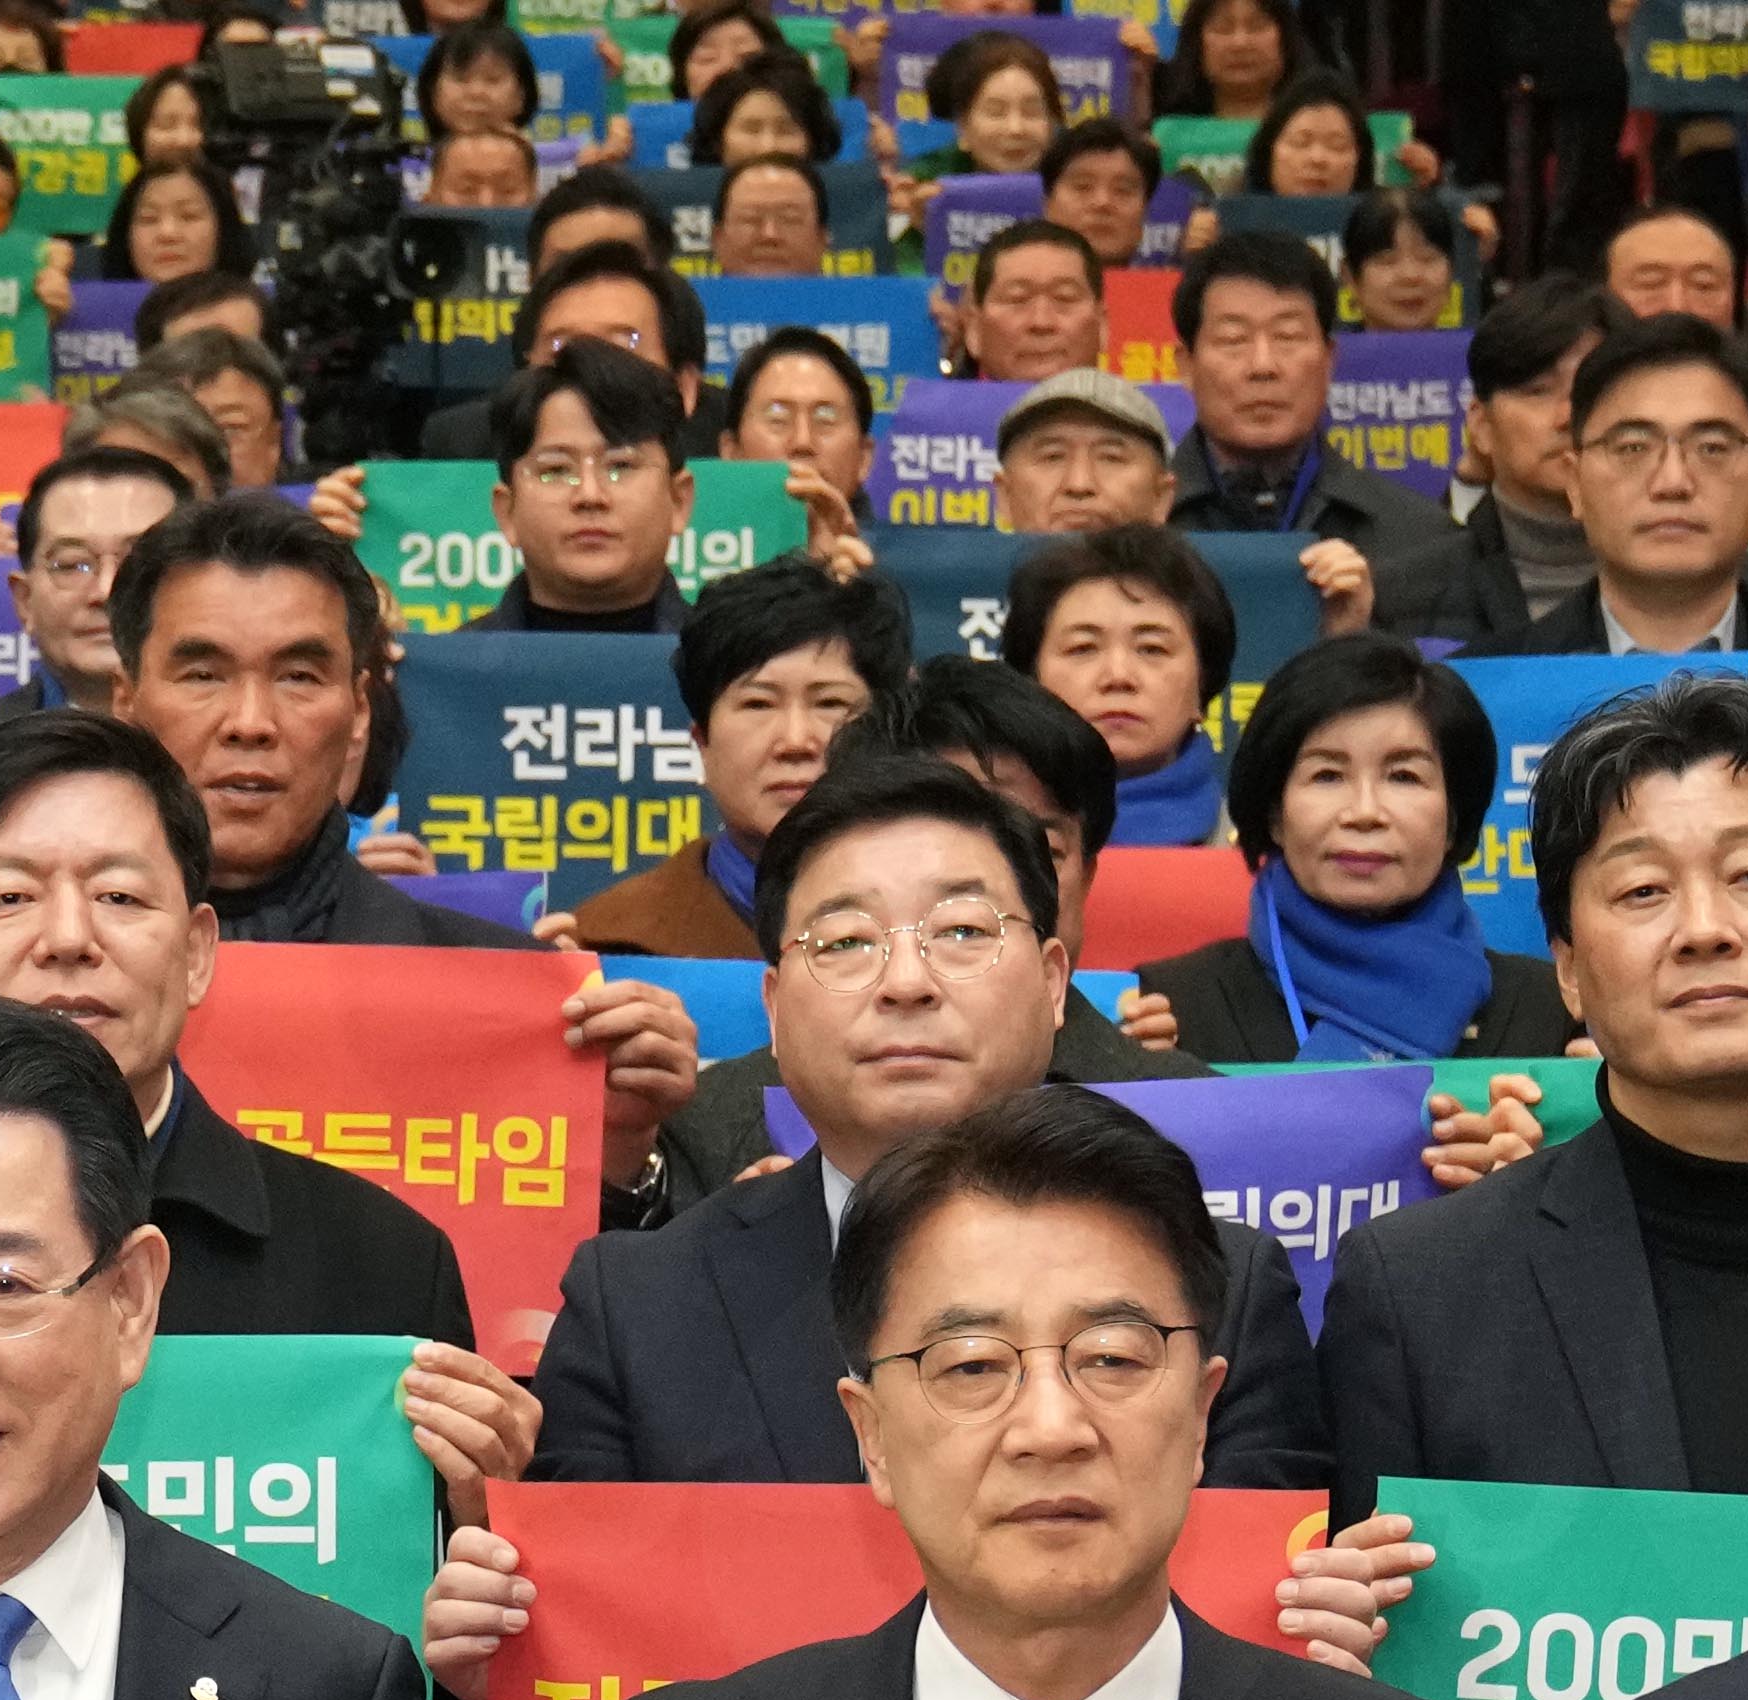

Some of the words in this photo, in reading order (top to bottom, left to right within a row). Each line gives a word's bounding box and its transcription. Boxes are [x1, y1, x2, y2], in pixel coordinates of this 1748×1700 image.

[1327, 380, 1452, 421] 전라남도
[891, 434, 1003, 483] 전라남
[1327, 423, 1451, 470] 이번에
[399, 532, 518, 589] 200
[502, 703, 705, 784] 전라남
[421, 794, 702, 874] 국립의대
[144, 1455, 339, 1565] 민의
